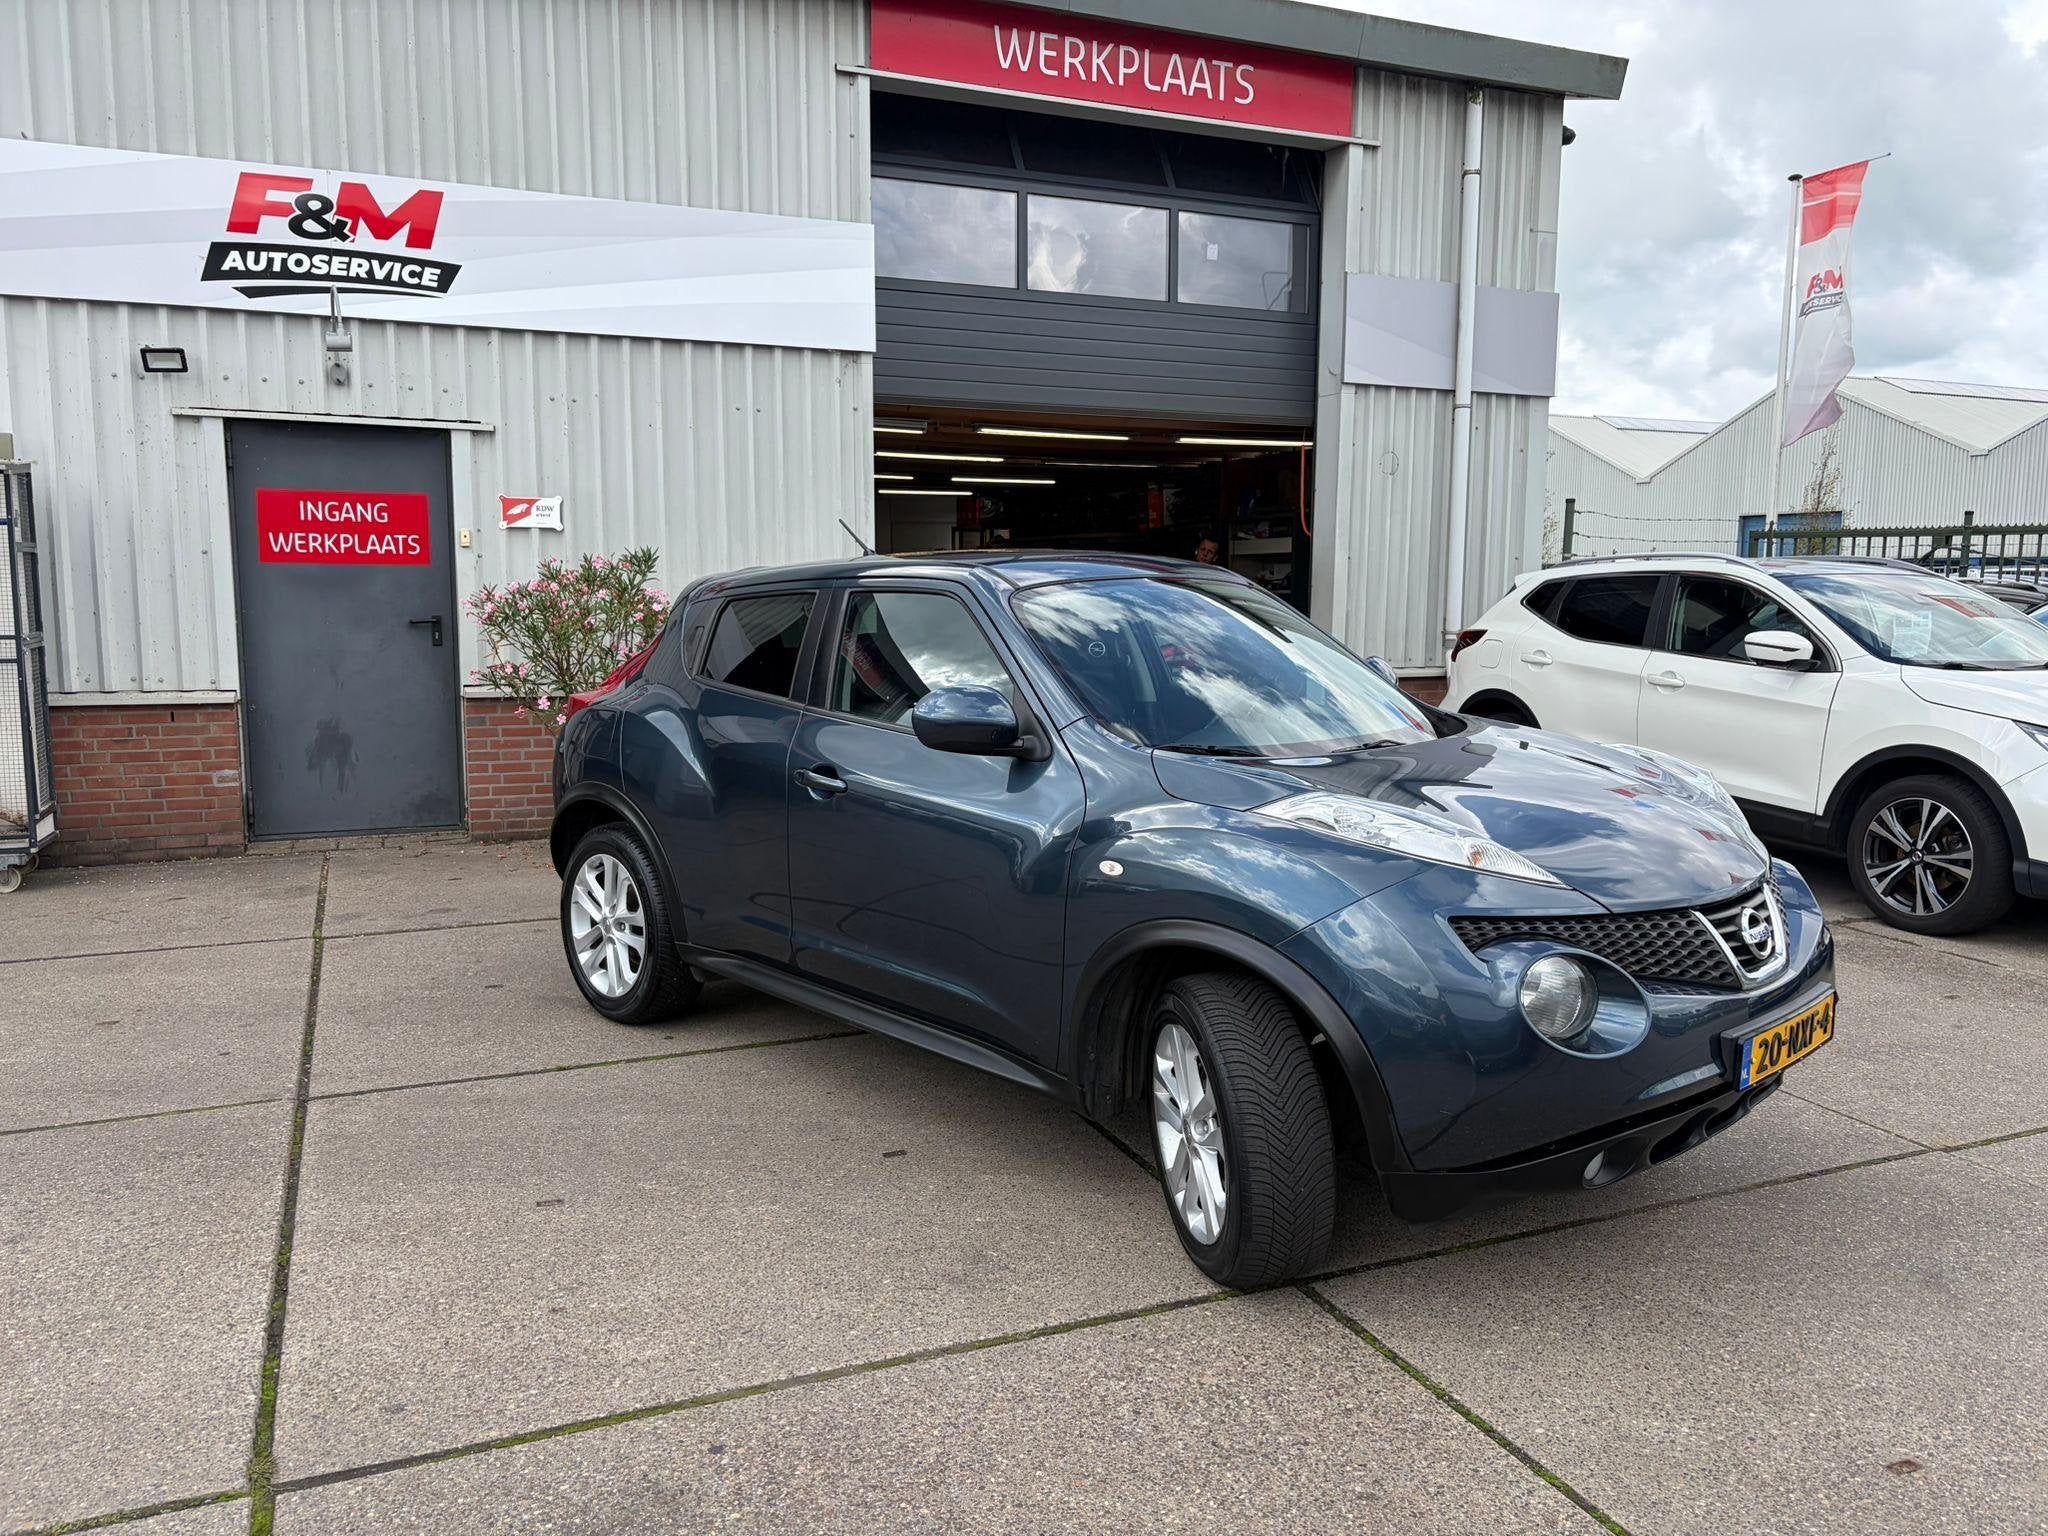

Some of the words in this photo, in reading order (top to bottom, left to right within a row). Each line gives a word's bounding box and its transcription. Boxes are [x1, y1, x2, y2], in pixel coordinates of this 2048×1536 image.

[994, 25, 1254, 104] WERKPLAATS
[226, 172, 444, 249] F&M
[221, 250, 442, 287] AUTOSERVICE
[300, 500, 388, 522] INGANG
[269, 532, 420, 555] WERKPLAATS
[1756, 1003, 1830, 1074] 20-NXF-4
